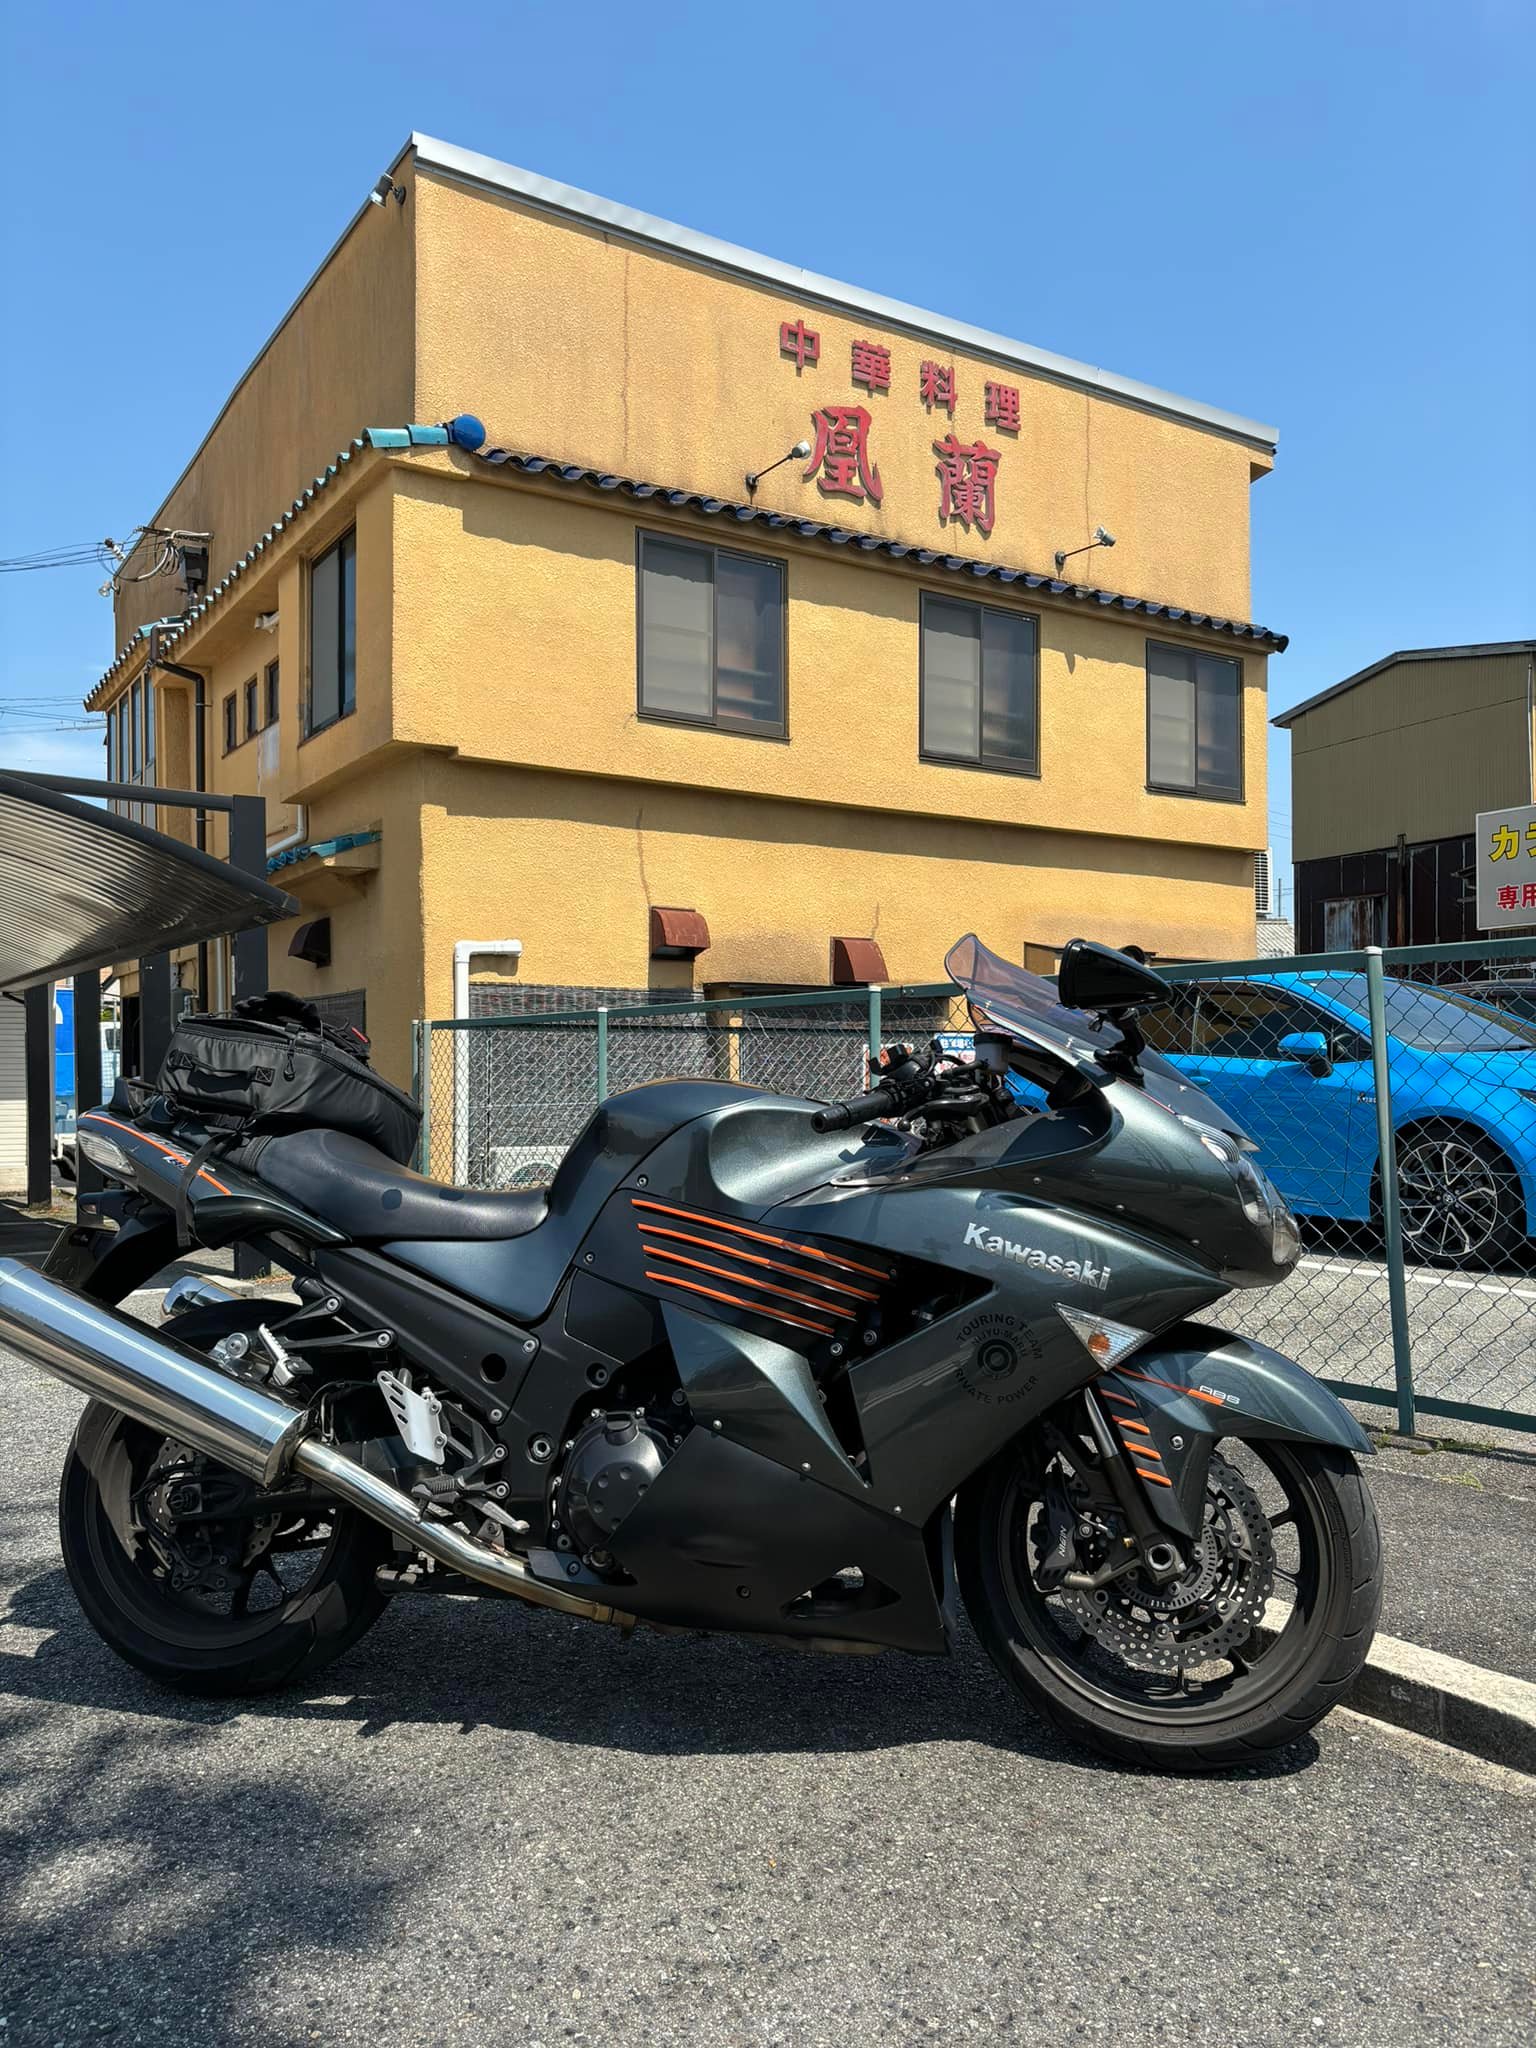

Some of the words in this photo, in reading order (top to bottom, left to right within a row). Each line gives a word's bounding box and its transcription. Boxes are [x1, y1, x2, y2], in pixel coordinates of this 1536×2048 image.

[780, 320, 1021, 431] 中華料理
[963, 1221, 1111, 1291] Kawasaki
[955, 1313, 1015, 1343] TOURING
[1018, 1321, 1043, 1360] TEAM
[997, 1375, 1040, 1405] POWER
[1199, 1385, 1240, 1405] ABS
